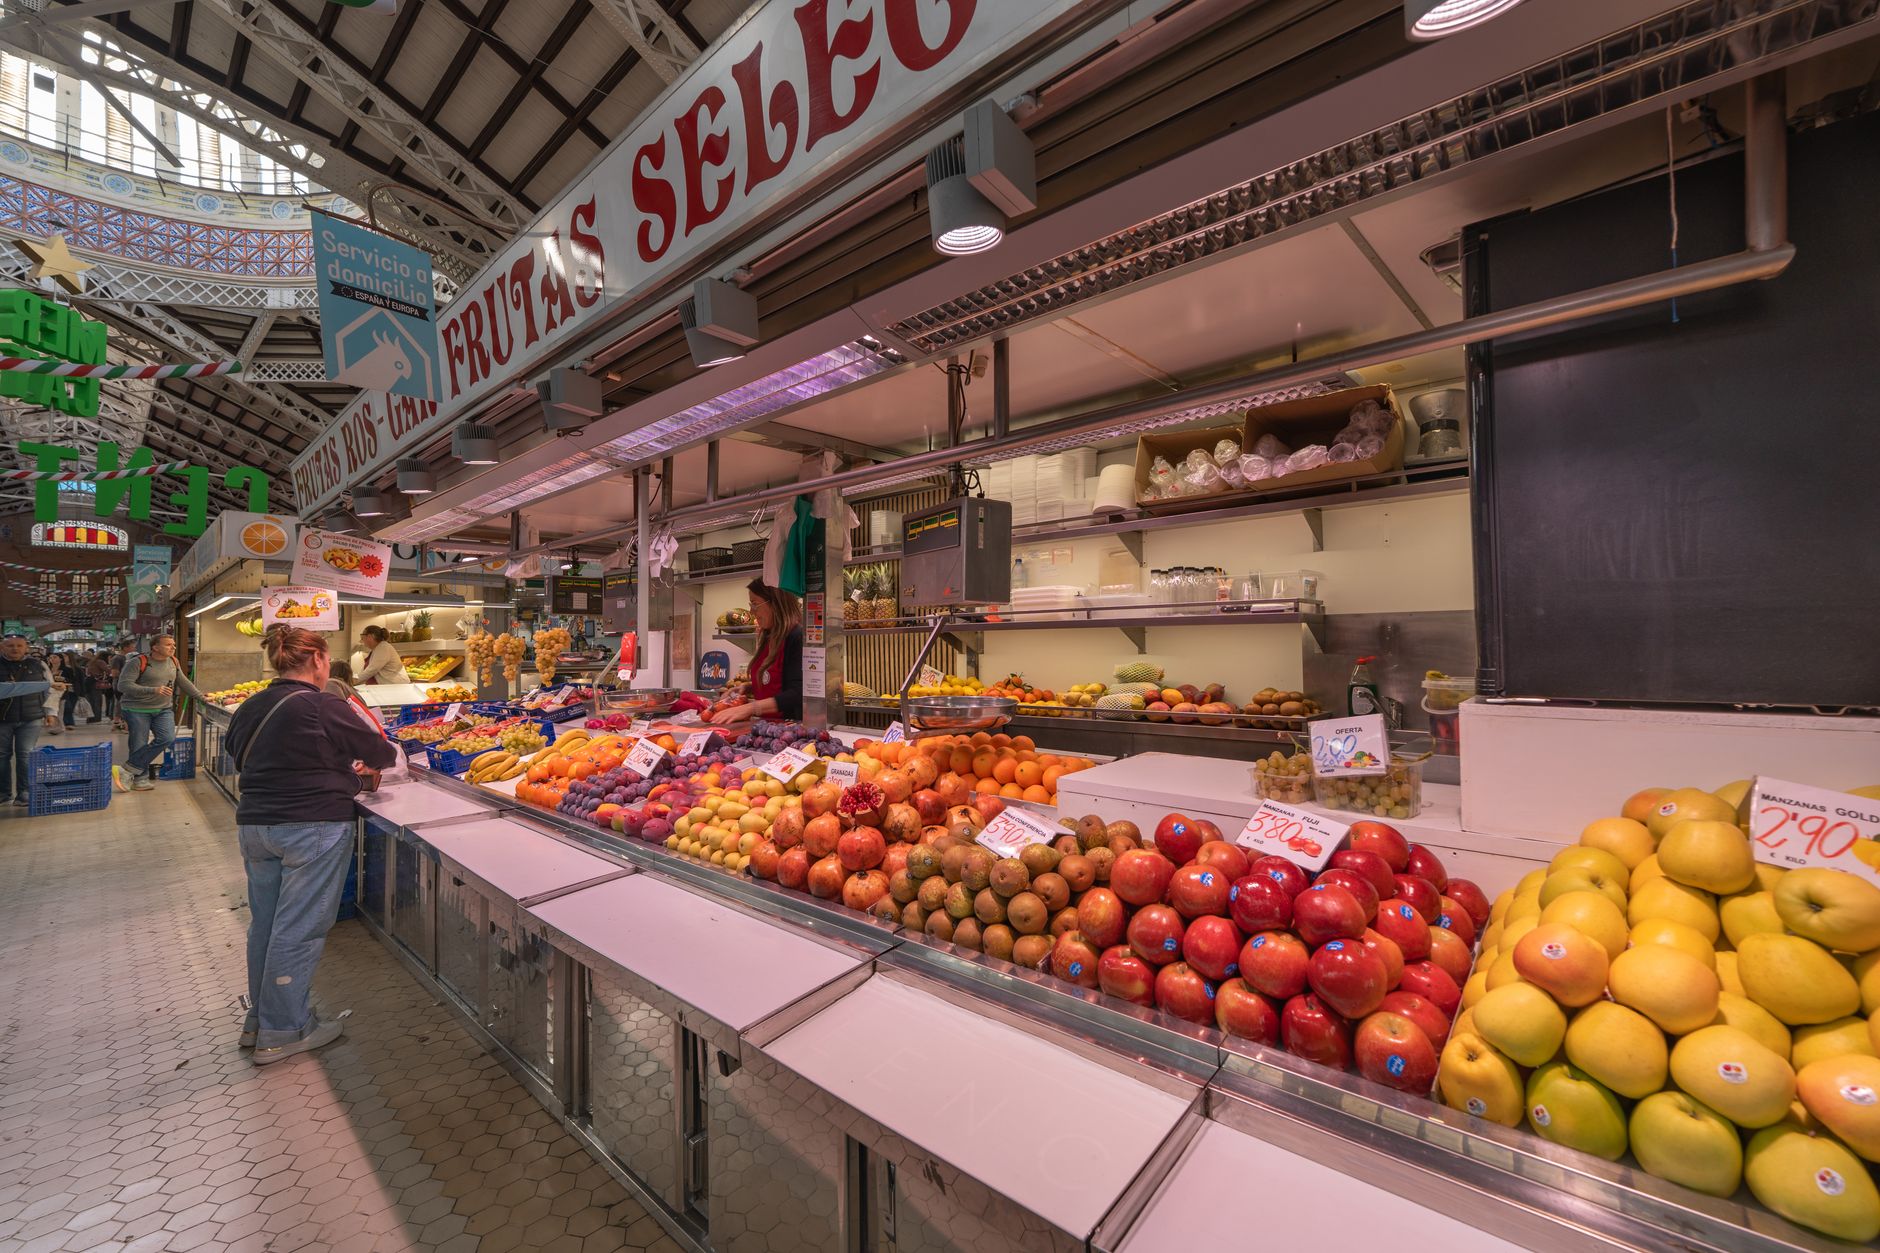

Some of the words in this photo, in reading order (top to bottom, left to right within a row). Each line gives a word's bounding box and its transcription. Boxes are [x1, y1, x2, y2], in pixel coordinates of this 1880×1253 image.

[322, 230, 411, 278] Servicio
[416, 269, 428, 285] a
[327, 259, 427, 306] domicilio
[354, 291, 385, 307] ESPAÑA
[385, 299, 391, 308] Y
[391, 301, 420, 317] EUROPA
[441, 193, 606, 400] FRUTAS
[294, 433, 341, 511] FRUTAS
[364, 561, 378, 571] 3€
[1335, 727, 1363, 735] OFERTA
[830, 768, 854, 777] GRANADAS
[52, 797, 83, 805] MONZO
[1761, 793, 1827, 812] MANZANAS
[1246, 811, 1303, 842] 3'80
[1263, 803, 1295, 818] MANZANAS
[1302, 816, 1320, 826] FUJI
[986, 816, 1025, 843] 3'90
[1014, 817, 1047, 838] CONFERENCIA
[1755, 807, 1859, 858] 2'90
[1785, 855, 1806, 865] KILO
